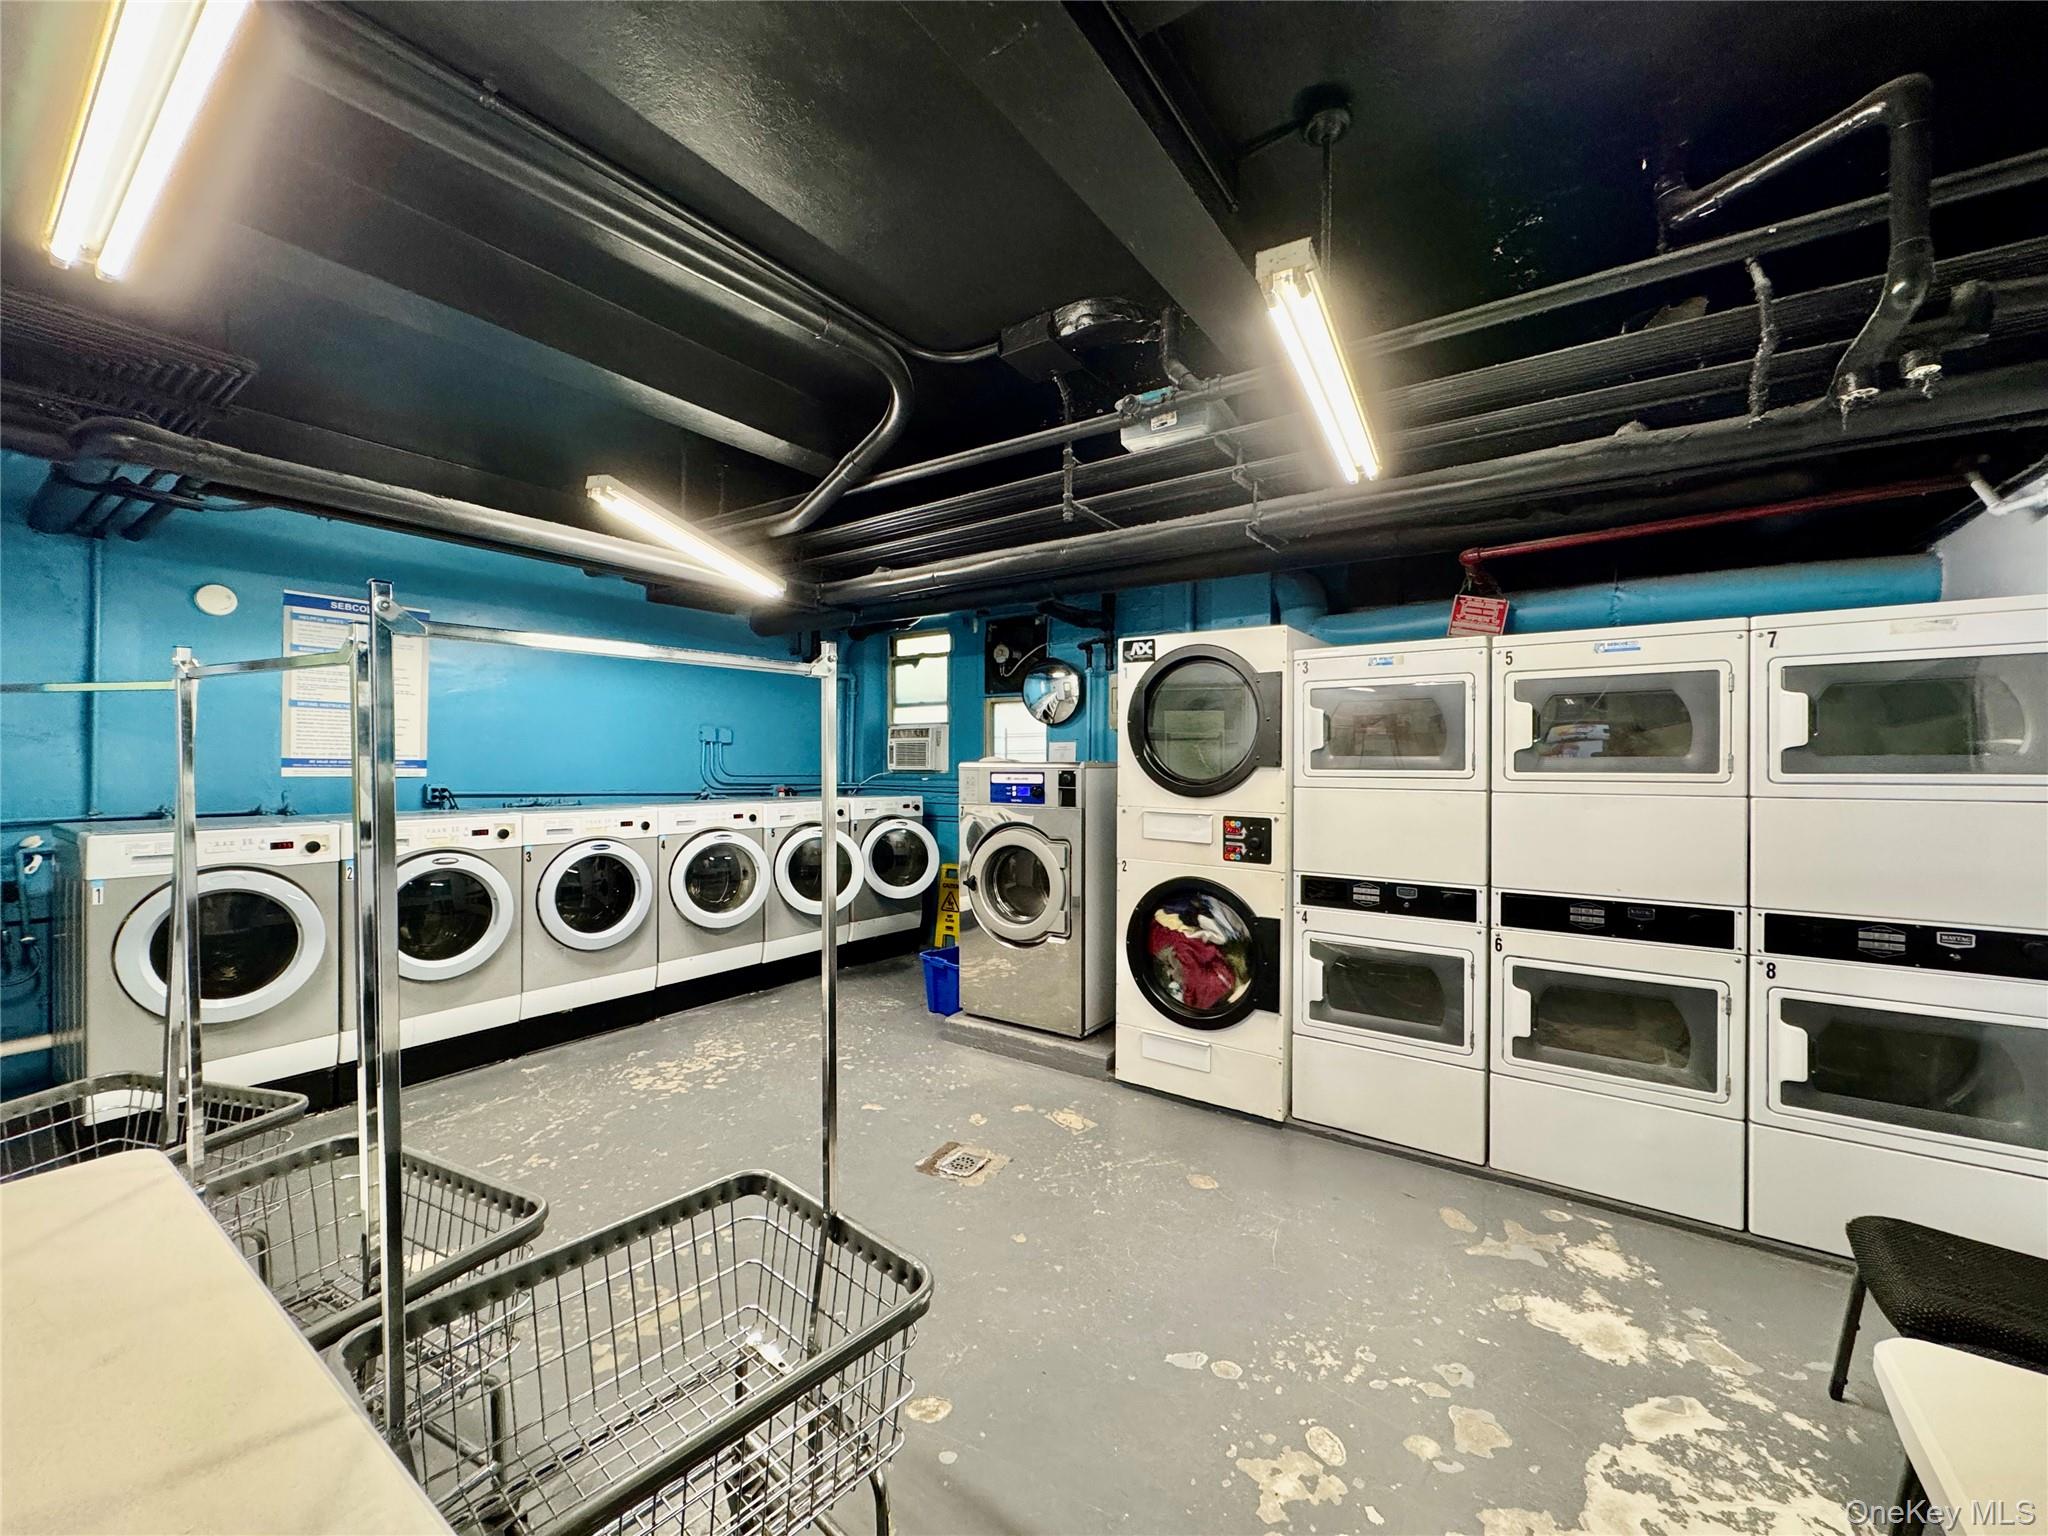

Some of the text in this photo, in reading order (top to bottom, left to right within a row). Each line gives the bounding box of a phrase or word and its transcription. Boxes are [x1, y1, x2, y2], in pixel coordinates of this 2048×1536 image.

[1767, 631, 1778, 648] 7
[1130, 640, 1153, 656] ADC
[1505, 650, 1513, 665] 5
[1302, 660, 1309, 674] 3
[771, 828, 776, 838] 5
[661, 840, 666, 850] 4
[526, 851, 532, 863] 3
[347, 866, 353, 881] 2
[1122, 860, 1127, 872] 2
[95, 887, 102, 904] 1
[1301, 910, 1308, 924] 4
[1494, 937, 1502, 952] 6
[1766, 962, 1777, 979] 8
